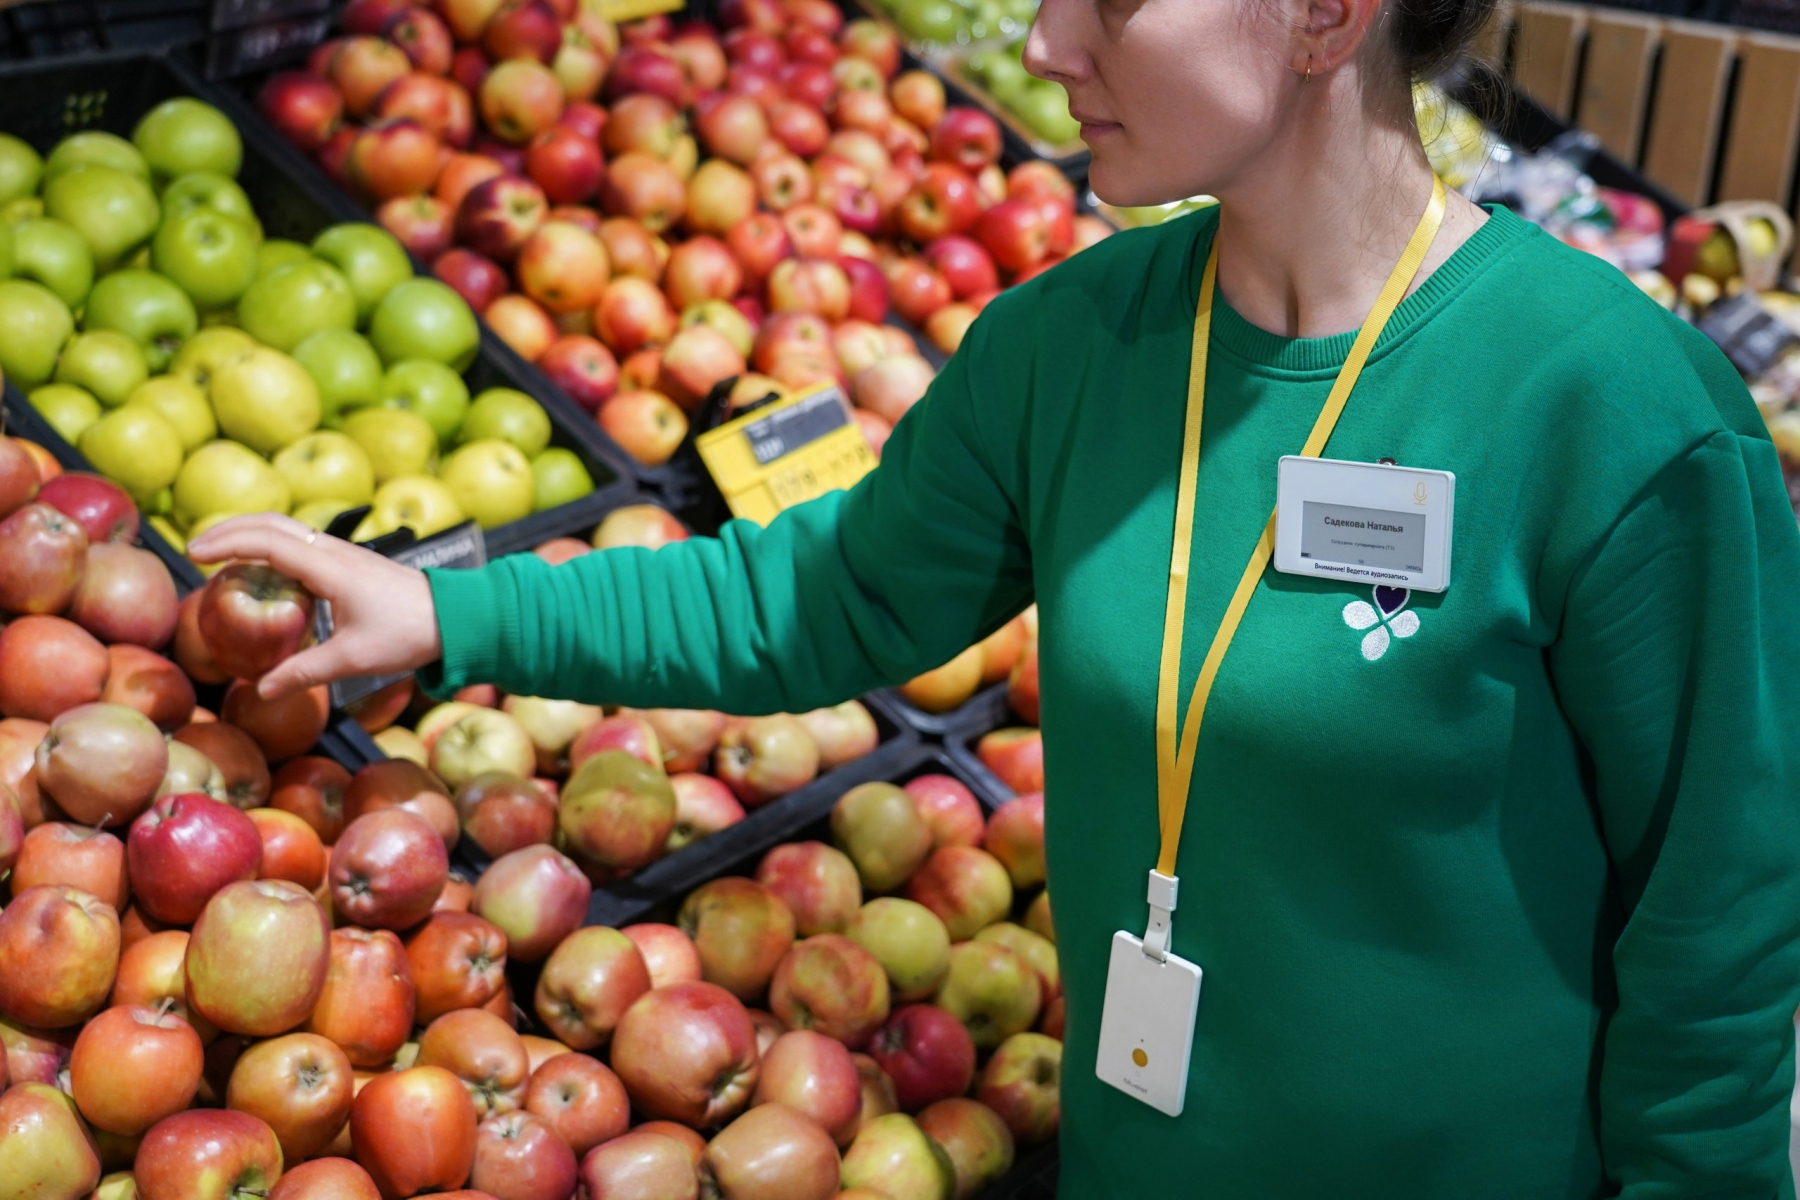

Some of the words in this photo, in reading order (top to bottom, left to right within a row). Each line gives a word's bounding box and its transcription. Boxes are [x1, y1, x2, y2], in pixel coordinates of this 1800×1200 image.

[1324, 516, 1365, 529] Садекова
[1367, 521, 1404, 533] Наталья
[1314, 562, 1346, 573] Внимание!
[1346, 566, 1370, 576] Ведется
[1370, 570, 1409, 581] аудиозапись
